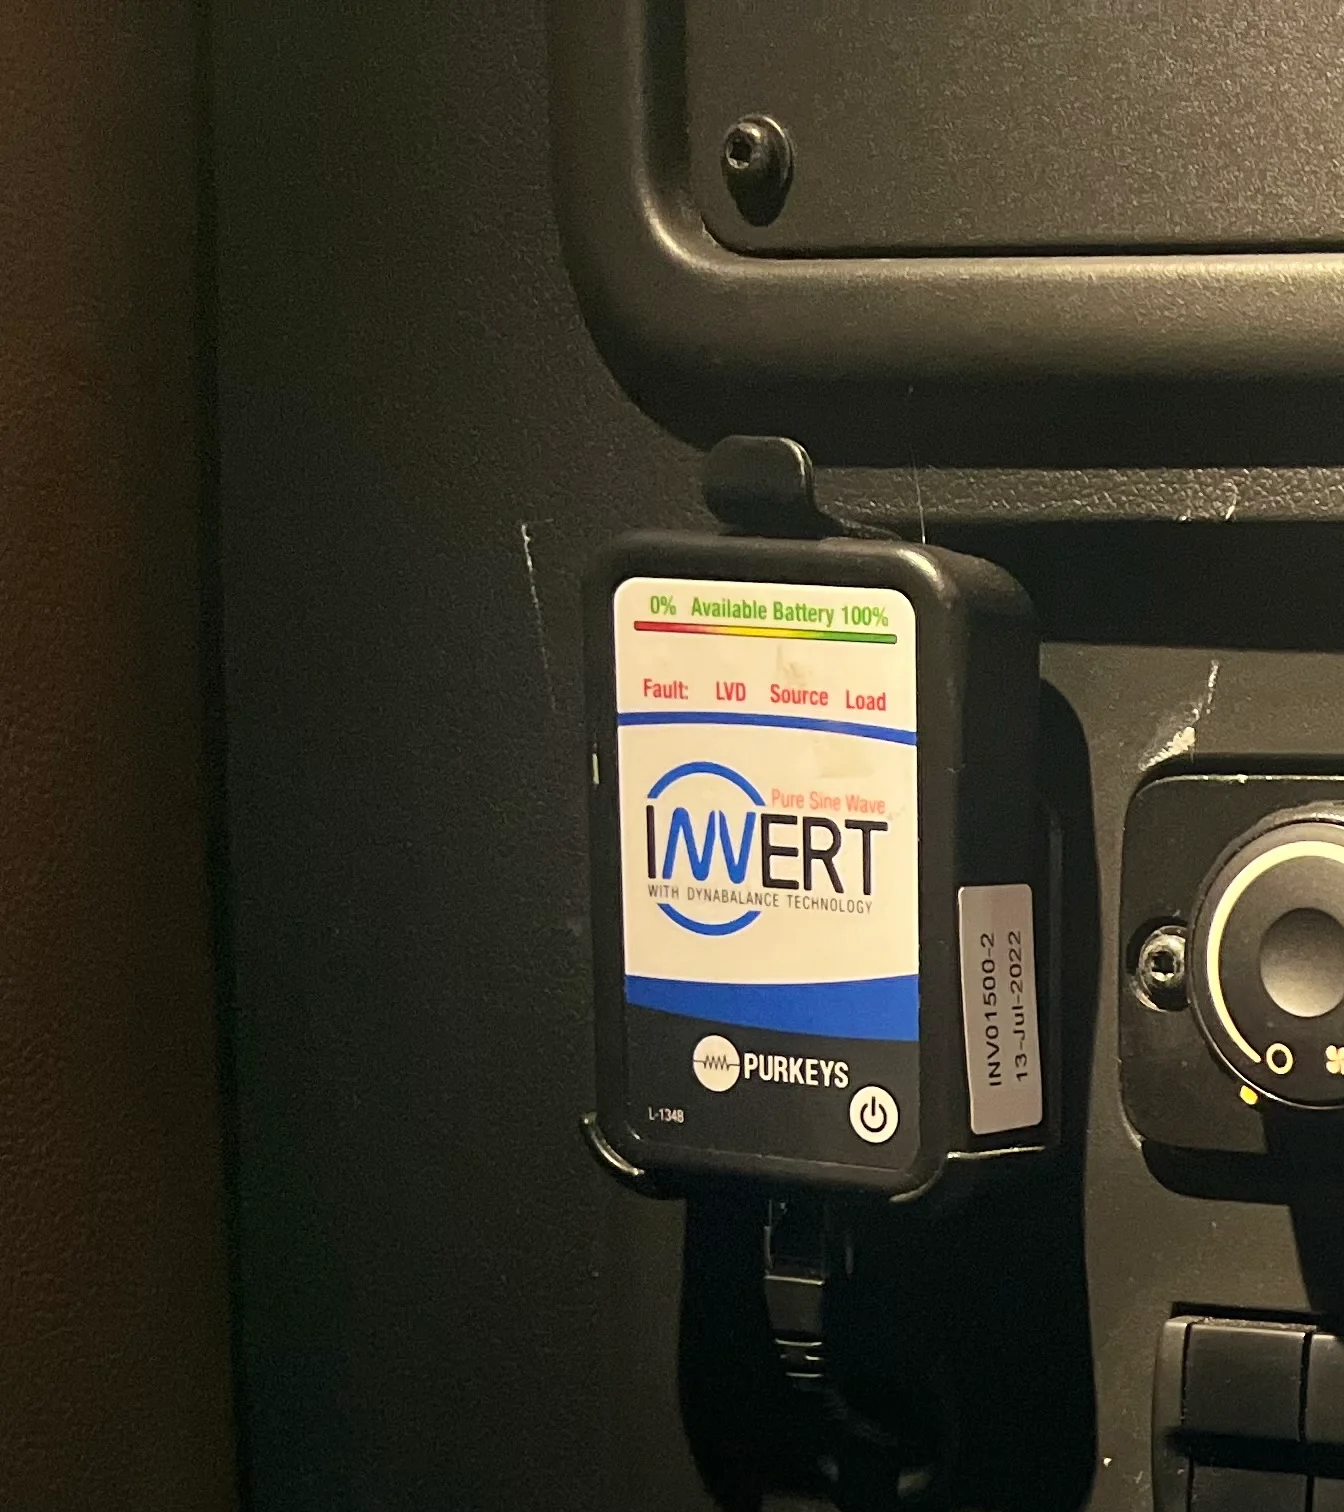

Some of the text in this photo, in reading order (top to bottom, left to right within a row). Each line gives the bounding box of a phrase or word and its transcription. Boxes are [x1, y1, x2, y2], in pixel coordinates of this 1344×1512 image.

[650, 595, 889, 627] 0% Available Battery 100%
[643, 678, 887, 712] Fault: LVD Source Load
[771, 788, 886, 815] Pure Sine Wave
[648, 884, 873, 914] WITH DYNABALANCE TECHNOLOGY
[1008, 930, 1029, 1082] 13-Jul-2022
[744, 1052, 850, 1089] PURKEYS
